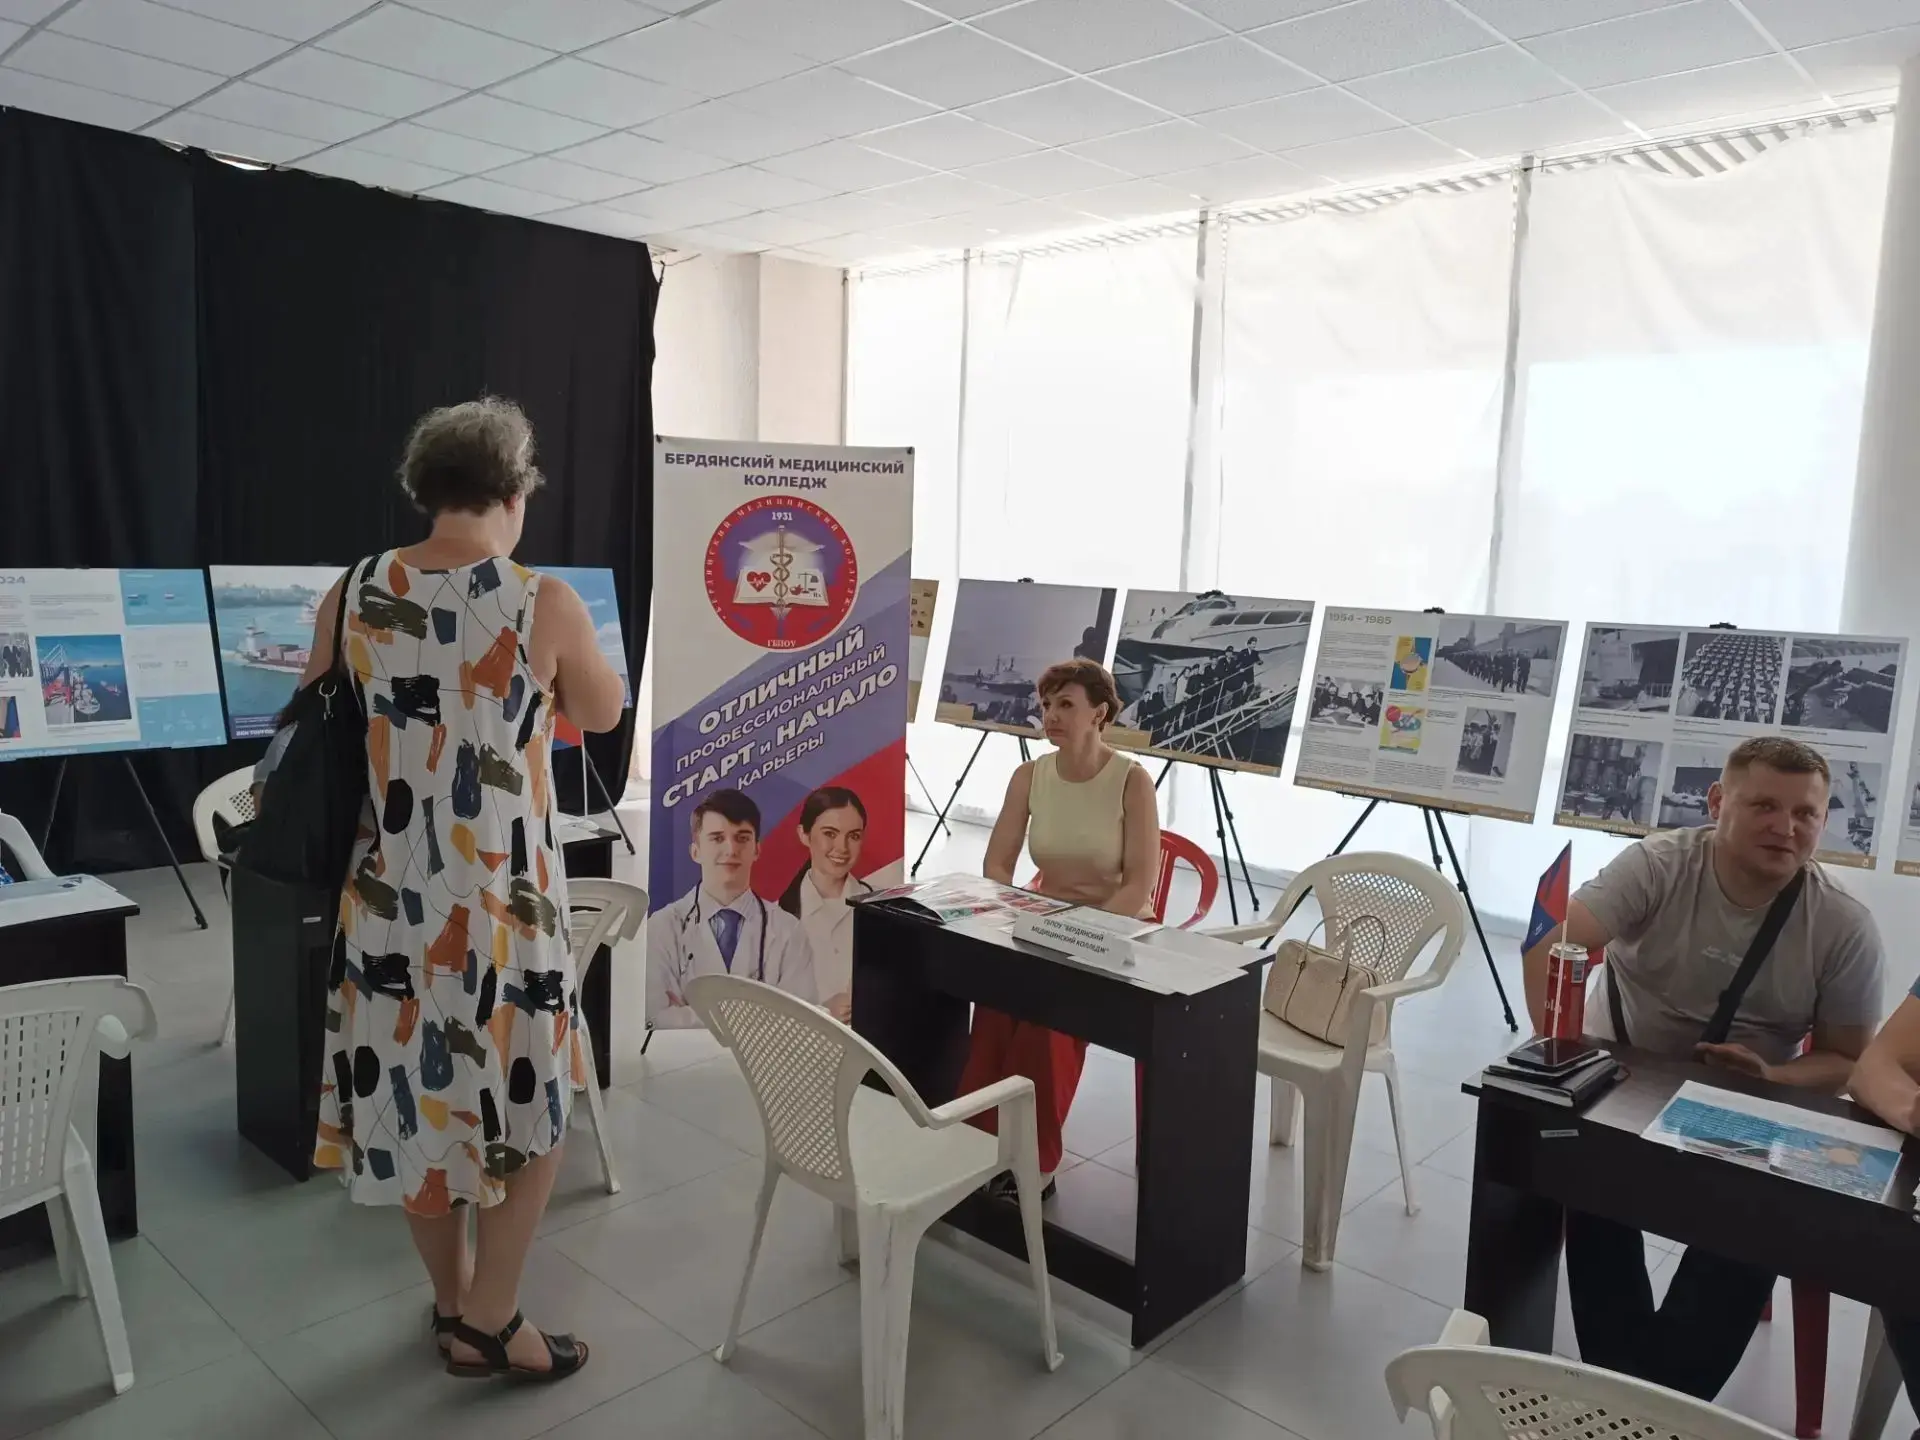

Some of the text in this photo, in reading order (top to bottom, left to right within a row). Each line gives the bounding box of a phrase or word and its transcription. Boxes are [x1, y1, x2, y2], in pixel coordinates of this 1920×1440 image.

[664, 452, 905, 474] БЕРДЯНСКИЙ МЕДИЦИНСКИЙ
[743, 474, 828, 489] КОЛЛЕДЖ
[771, 511, 793, 521] 1931
[1365, 615, 1392, 624] 1985
[767, 639, 797, 648] ГБПОУ
[699, 625, 865, 735] ОТЛИЧНЫЙ
[676, 643, 886, 773] ПРОФЕССИОНАЛЬНЫЙ
[662, 742, 756, 808] СТАРТ
[776, 664, 898, 747] НАЧАЛО
[737, 732, 825, 791] КАРЬЕРЫ
[1031, 925, 1076, 944] МЕДИЦИНСКИЙ
